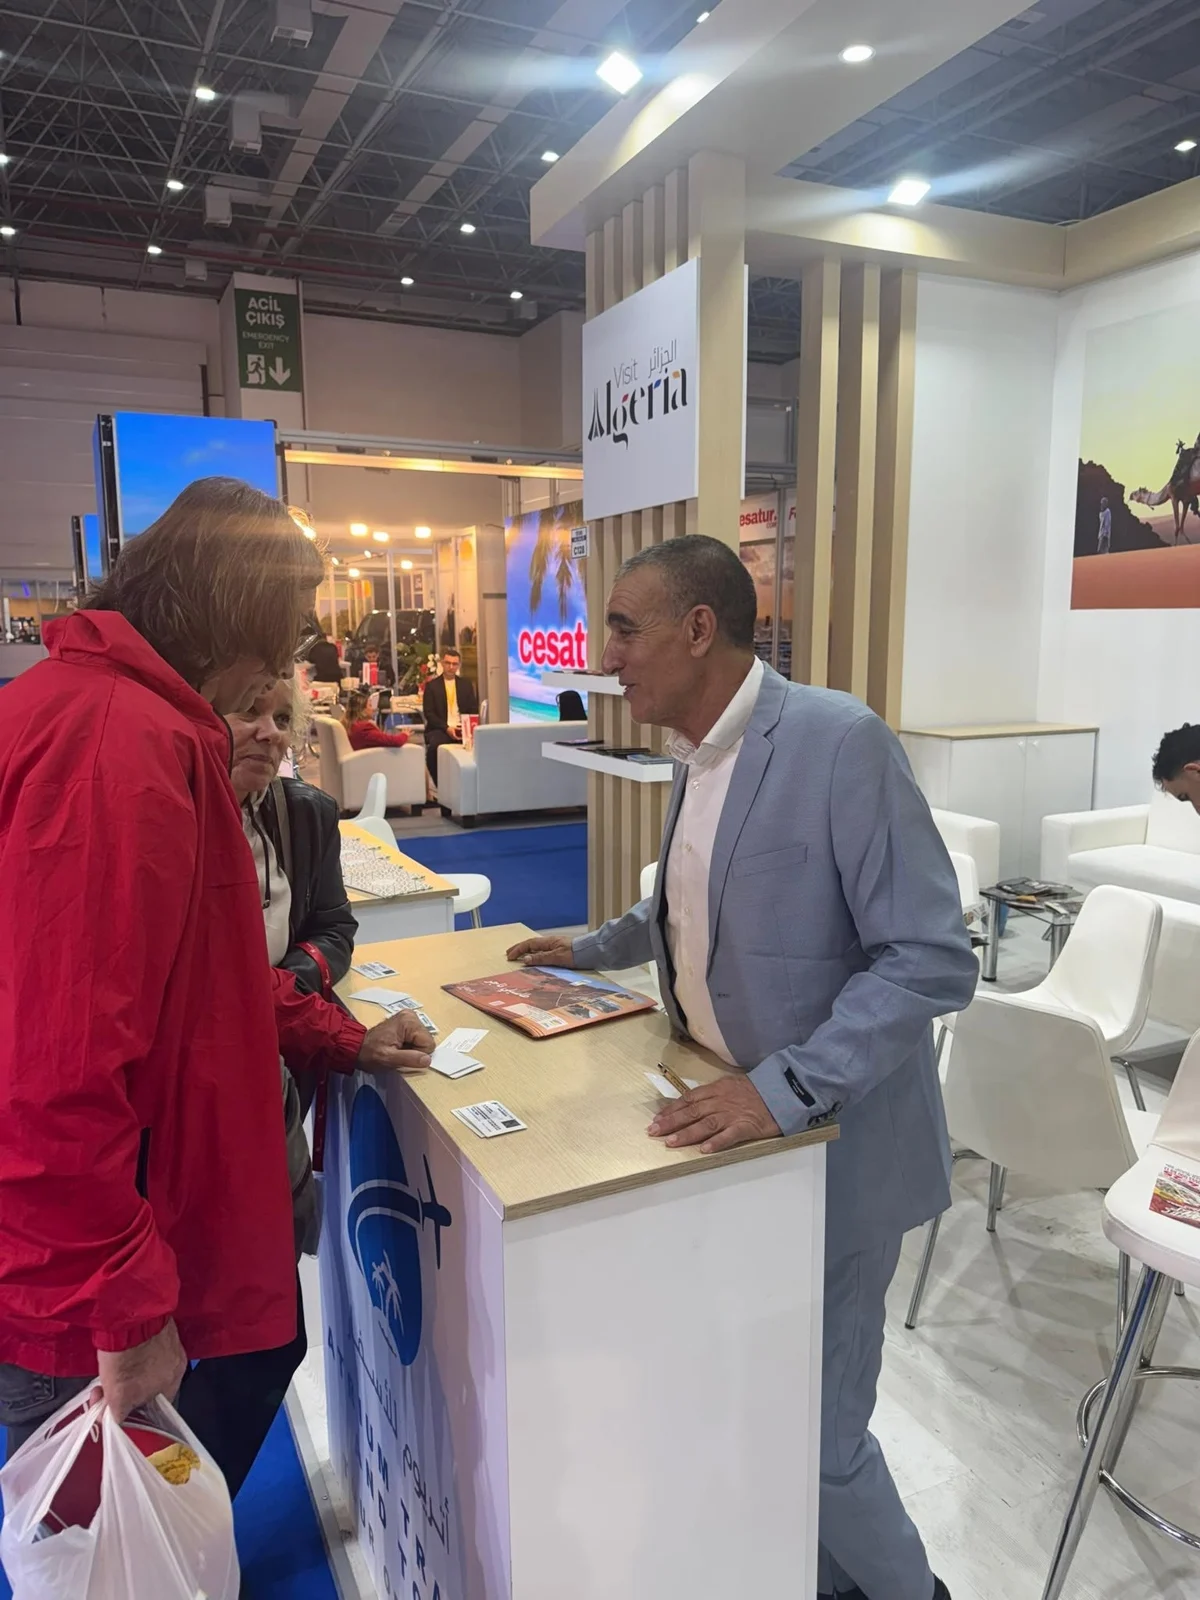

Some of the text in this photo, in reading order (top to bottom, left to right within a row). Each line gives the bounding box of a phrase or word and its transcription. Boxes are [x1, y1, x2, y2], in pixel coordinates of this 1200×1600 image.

[248, 296, 281, 311] ACİL
[245, 311, 285, 328] ÇIKIŞ
[258, 342, 274, 350] EXIT
[648, 339, 677, 378] الجزائر
[613, 358, 638, 388] Visit
[587, 367, 688, 450] Algeria
[740, 508, 777, 526] esatur.
[519, 622, 588, 669] cesat
[328, 1325, 389, 1493] ATRIUM
